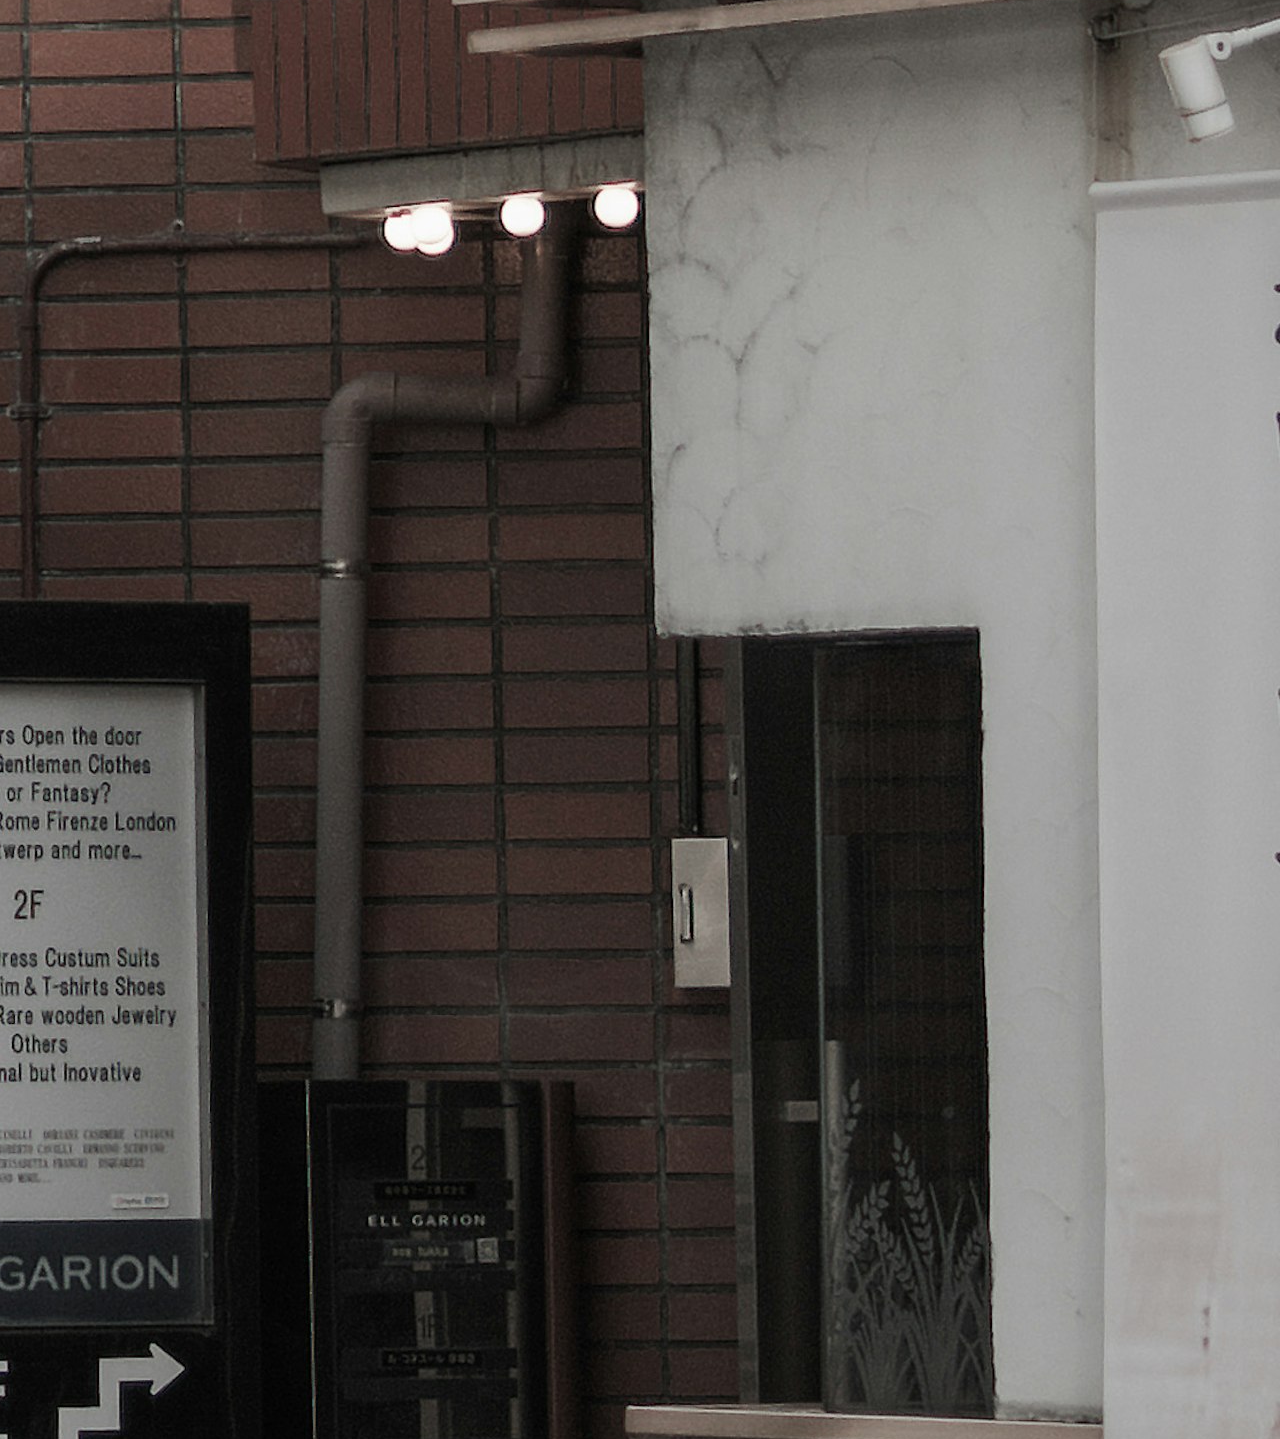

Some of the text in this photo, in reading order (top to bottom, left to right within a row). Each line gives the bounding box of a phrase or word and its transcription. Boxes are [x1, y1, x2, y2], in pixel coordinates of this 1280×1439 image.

[22, 724, 65, 747] Open
[72, 724, 98, 745] the
[105, 725, 143, 746] door
[89, 753, 151, 774] Clothes
[7, 786, 24, 801] or
[31, 781, 111, 805] Fantasy?
[47, 810, 108, 831] Firenze
[115, 810, 177, 832] London
[51, 840, 81, 860] and
[14, 889, 44, 920] 2F
[45, 947, 110, 968] Custum
[117, 947, 160, 968] Suits
[24, 977, 37, 996] &
[42, 976, 108, 996] T-shirts
[115, 976, 166, 996] Shoes
[41, 1005, 105, 1025] wooden
[112, 1005, 177, 1028] Jewelry
[11, 1034, 68, 1054] Others
[29, 1062, 56, 1083] but
[63, 1062, 142, 1083] Inovative
[367, 1214, 486, 1227] ELL GARION
